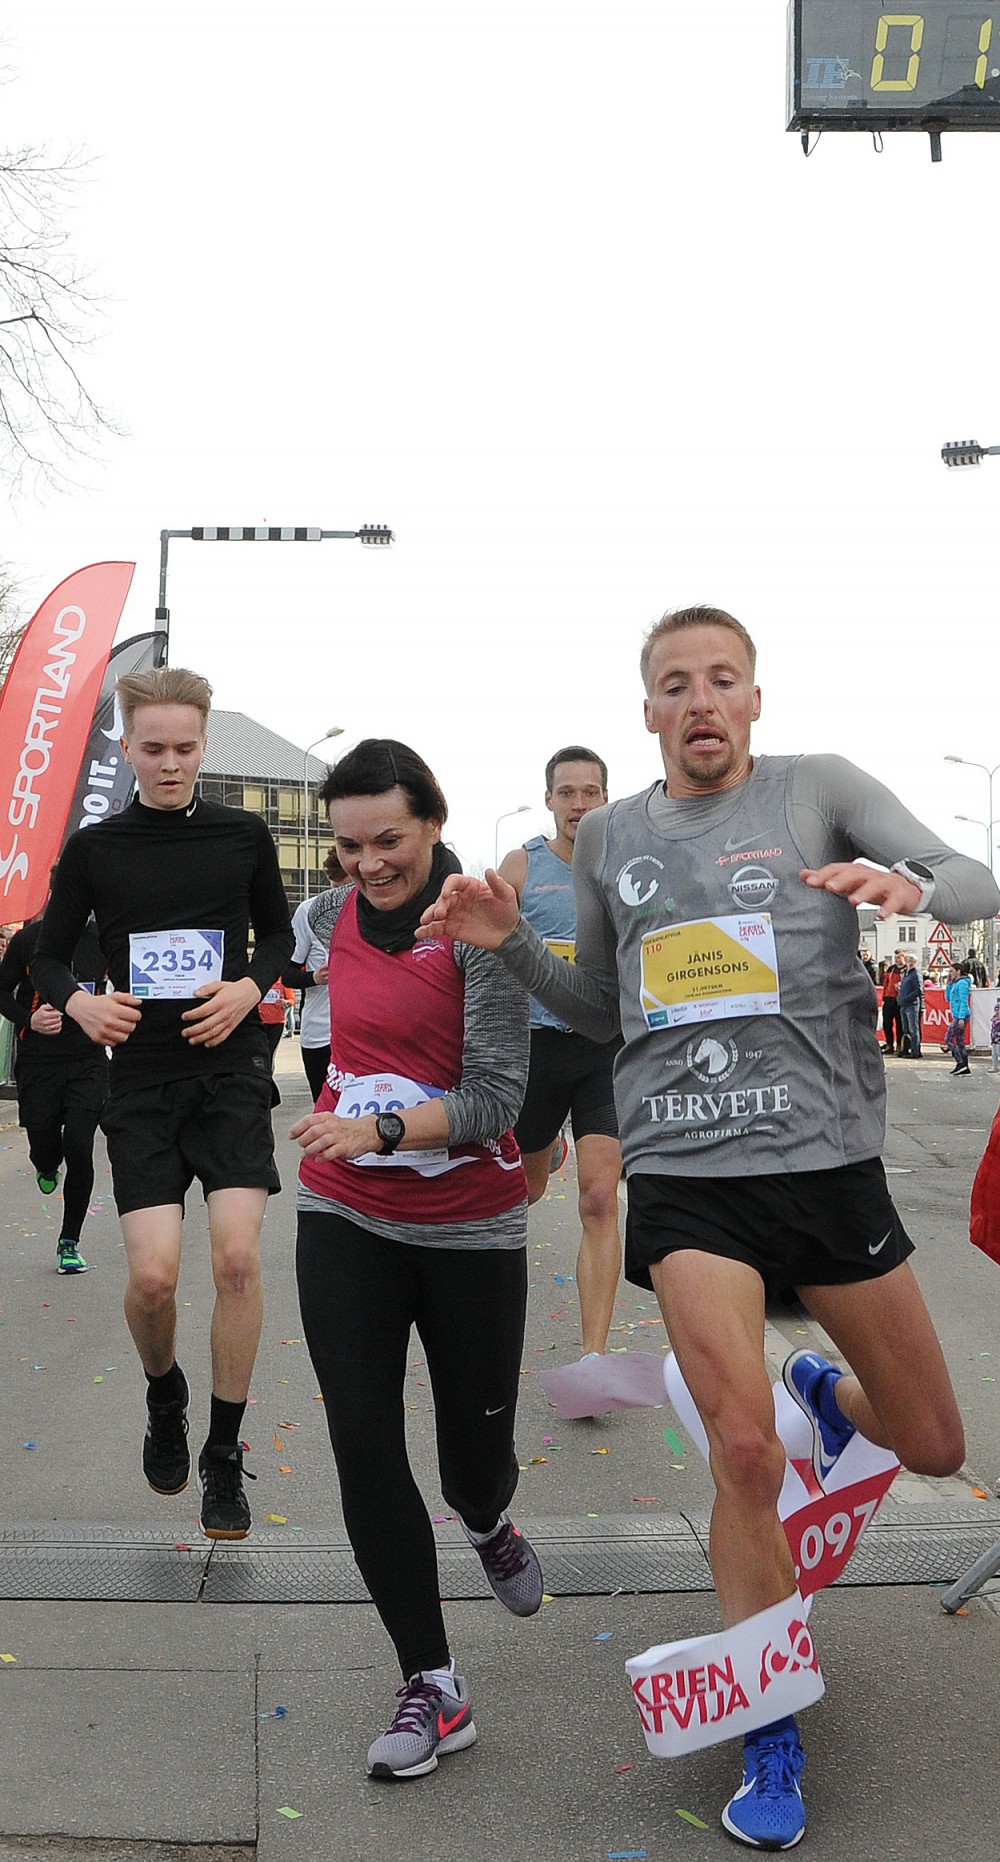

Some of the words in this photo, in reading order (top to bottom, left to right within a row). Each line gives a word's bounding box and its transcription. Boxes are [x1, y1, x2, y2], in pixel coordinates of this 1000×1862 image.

[8, 604, 86, 829] SPORTLAND
[87, 756, 119, 789] IT.
[731, 881, 775, 893] NISSAN
[645, 943, 662, 955] 110
[143, 949, 213, 972] 2354
[667, 961, 749, 982] GIRGENSONS
[745, 1050, 762, 1059] 1947
[642, 1084, 792, 1122] TĒRVETE
[684, 1127, 749, 1140] AGROFIRMA
